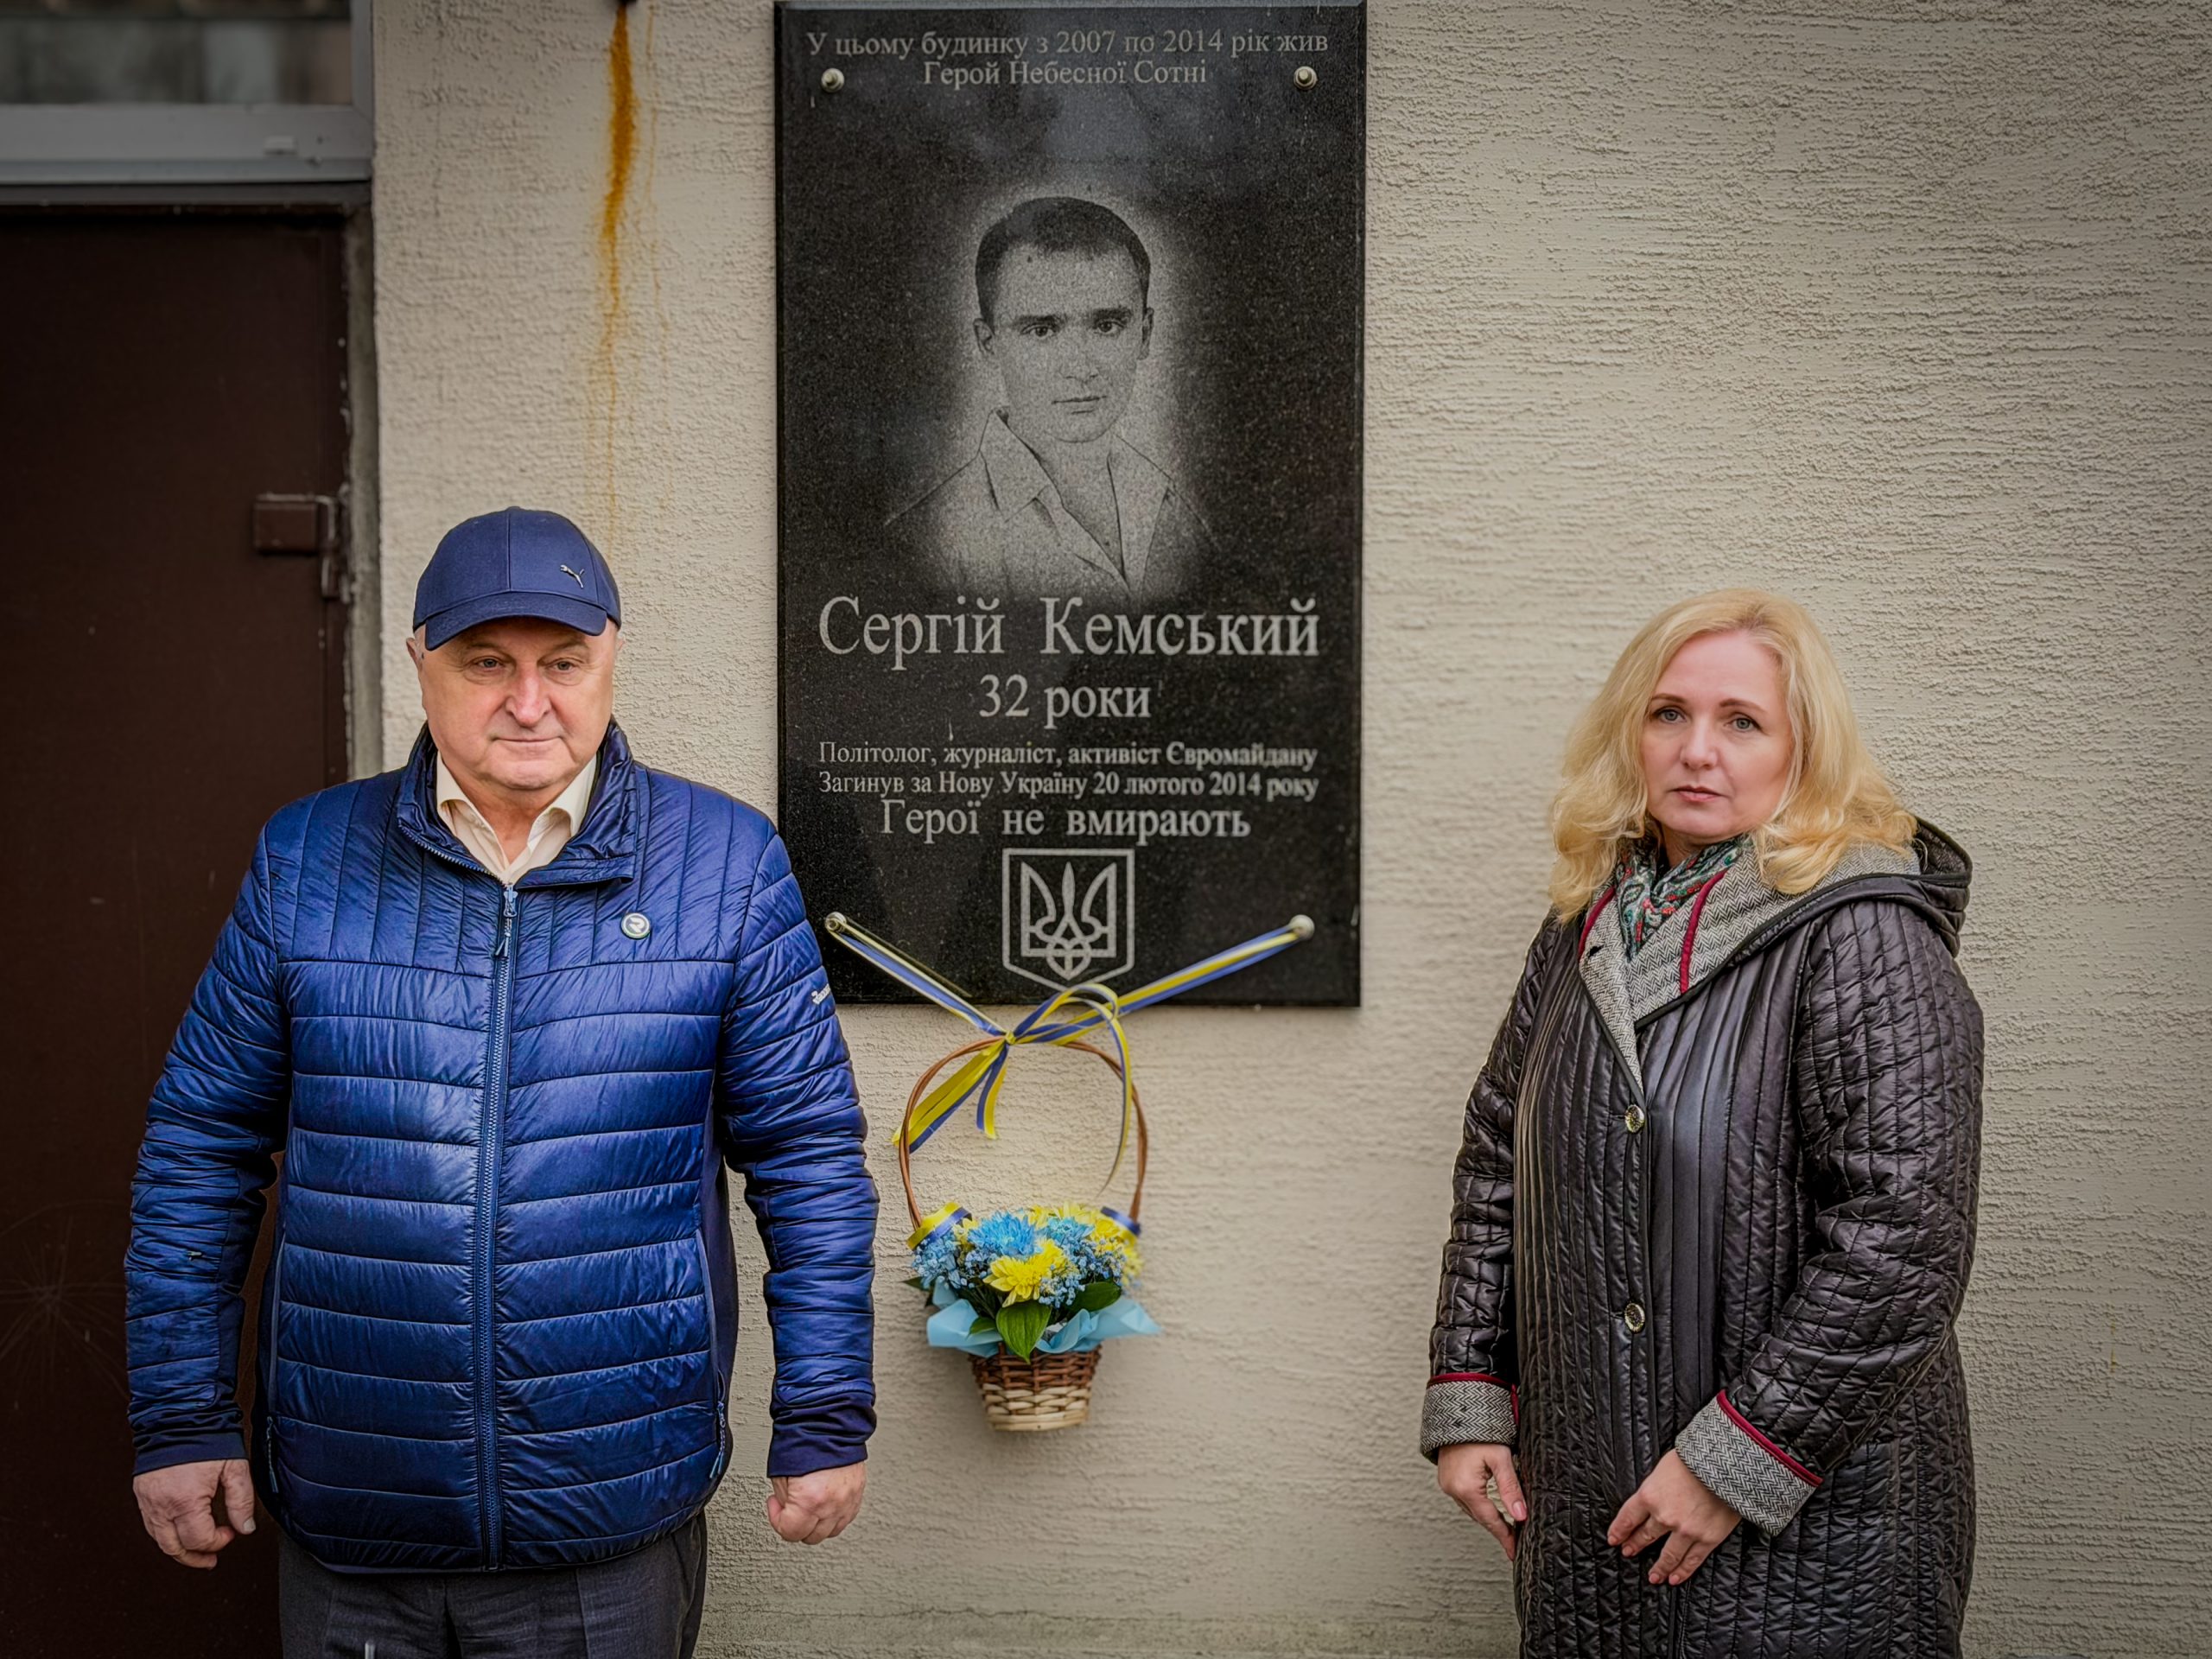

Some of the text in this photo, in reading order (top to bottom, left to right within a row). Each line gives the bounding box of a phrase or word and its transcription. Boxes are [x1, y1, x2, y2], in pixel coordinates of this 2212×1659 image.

[805, 29, 1329, 60] У цьому будинку з 2007 по 2014 рік жив
[923, 60, 1207, 90] Герой Небесної Сотні
[819, 595, 1320, 671] Сергій Кемський
[979, 674, 1152, 729] 32 роки
[819, 741, 1319, 771] Політолог, журналіст, активіст Євромайдану
[818, 772, 1319, 802] Загинув за Нову Україну 20 лютого 2014 року
[880, 799, 1252, 845] Герої не вмирають
